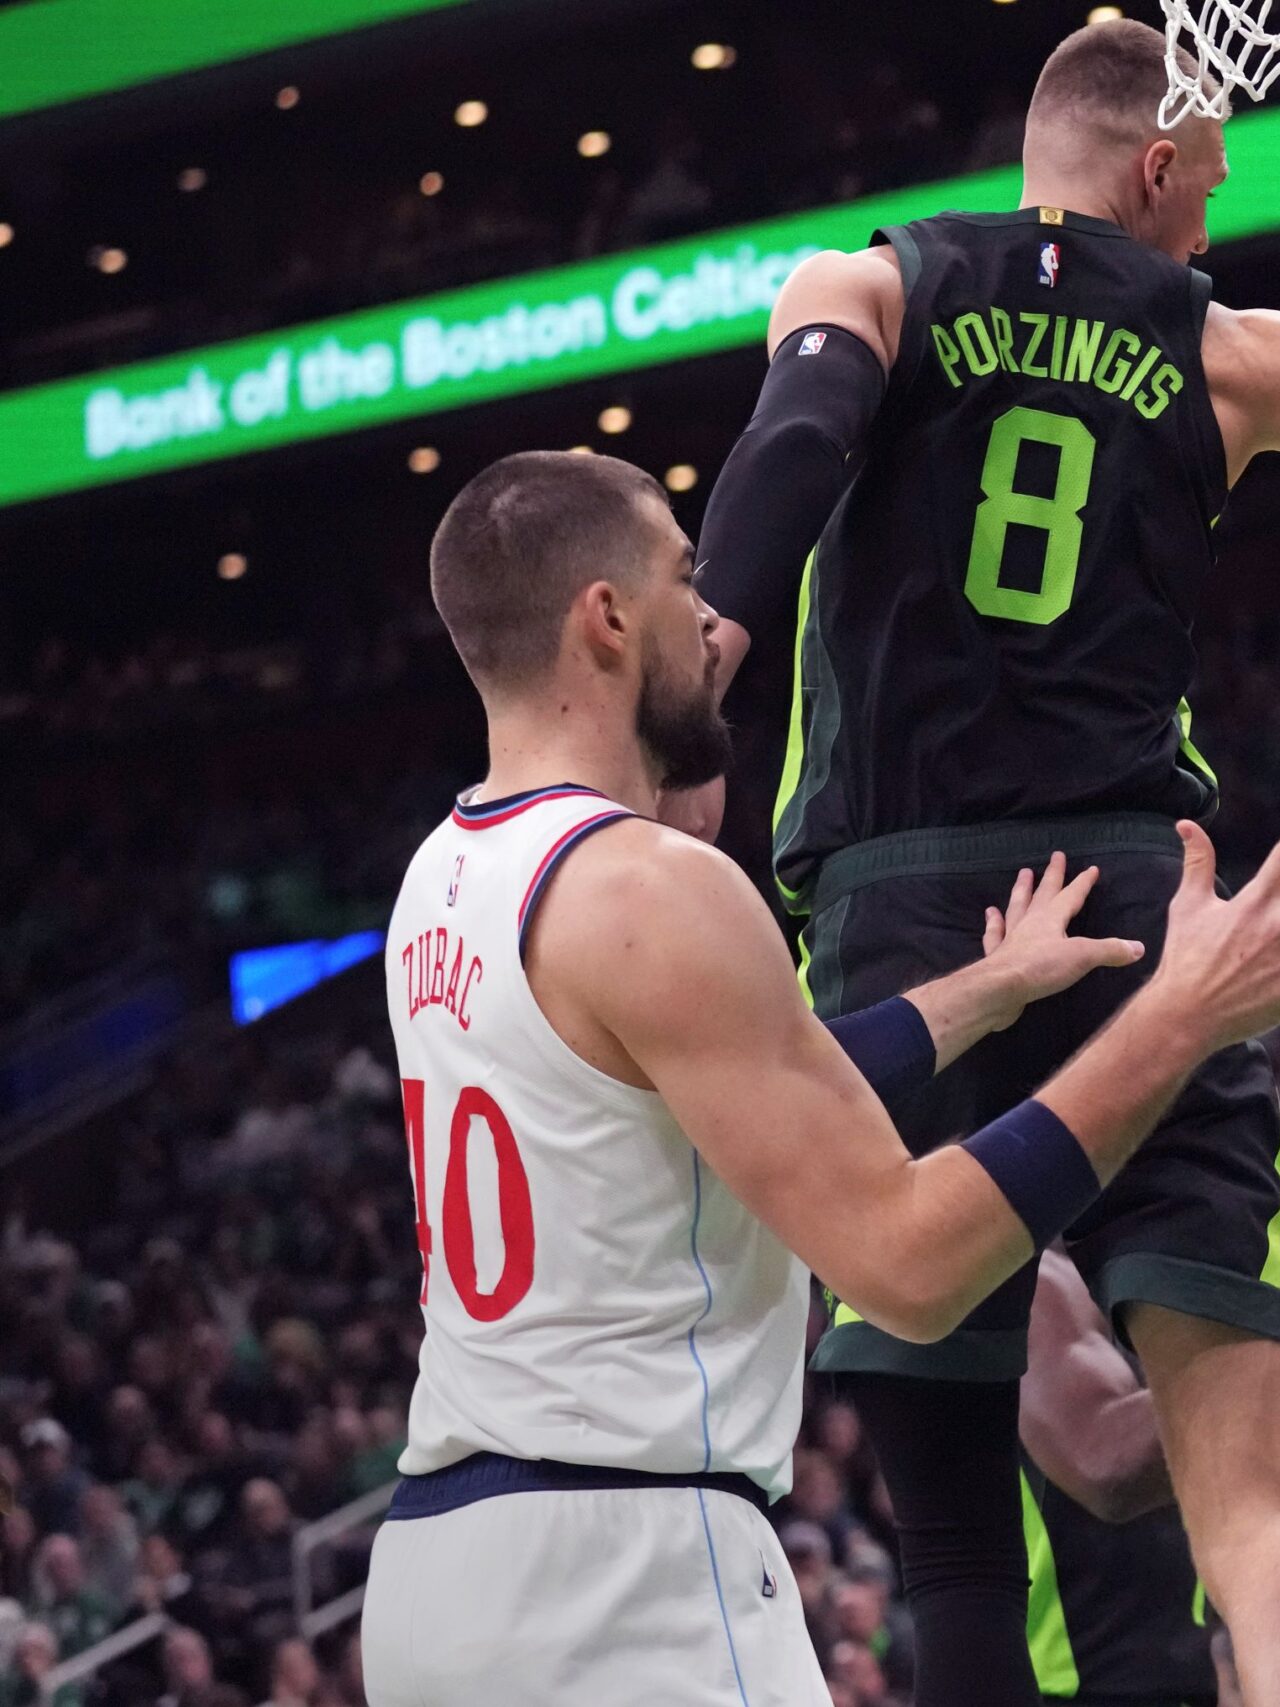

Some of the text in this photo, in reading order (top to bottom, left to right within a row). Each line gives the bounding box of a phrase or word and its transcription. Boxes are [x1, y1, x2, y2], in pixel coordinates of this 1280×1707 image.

[86, 243, 820, 459] Bank of the Boston Celtic
[930, 306, 1184, 419] PORZINGIS
[963, 405, 1097, 625] 8
[402, 927, 483, 1031] ZUBAC
